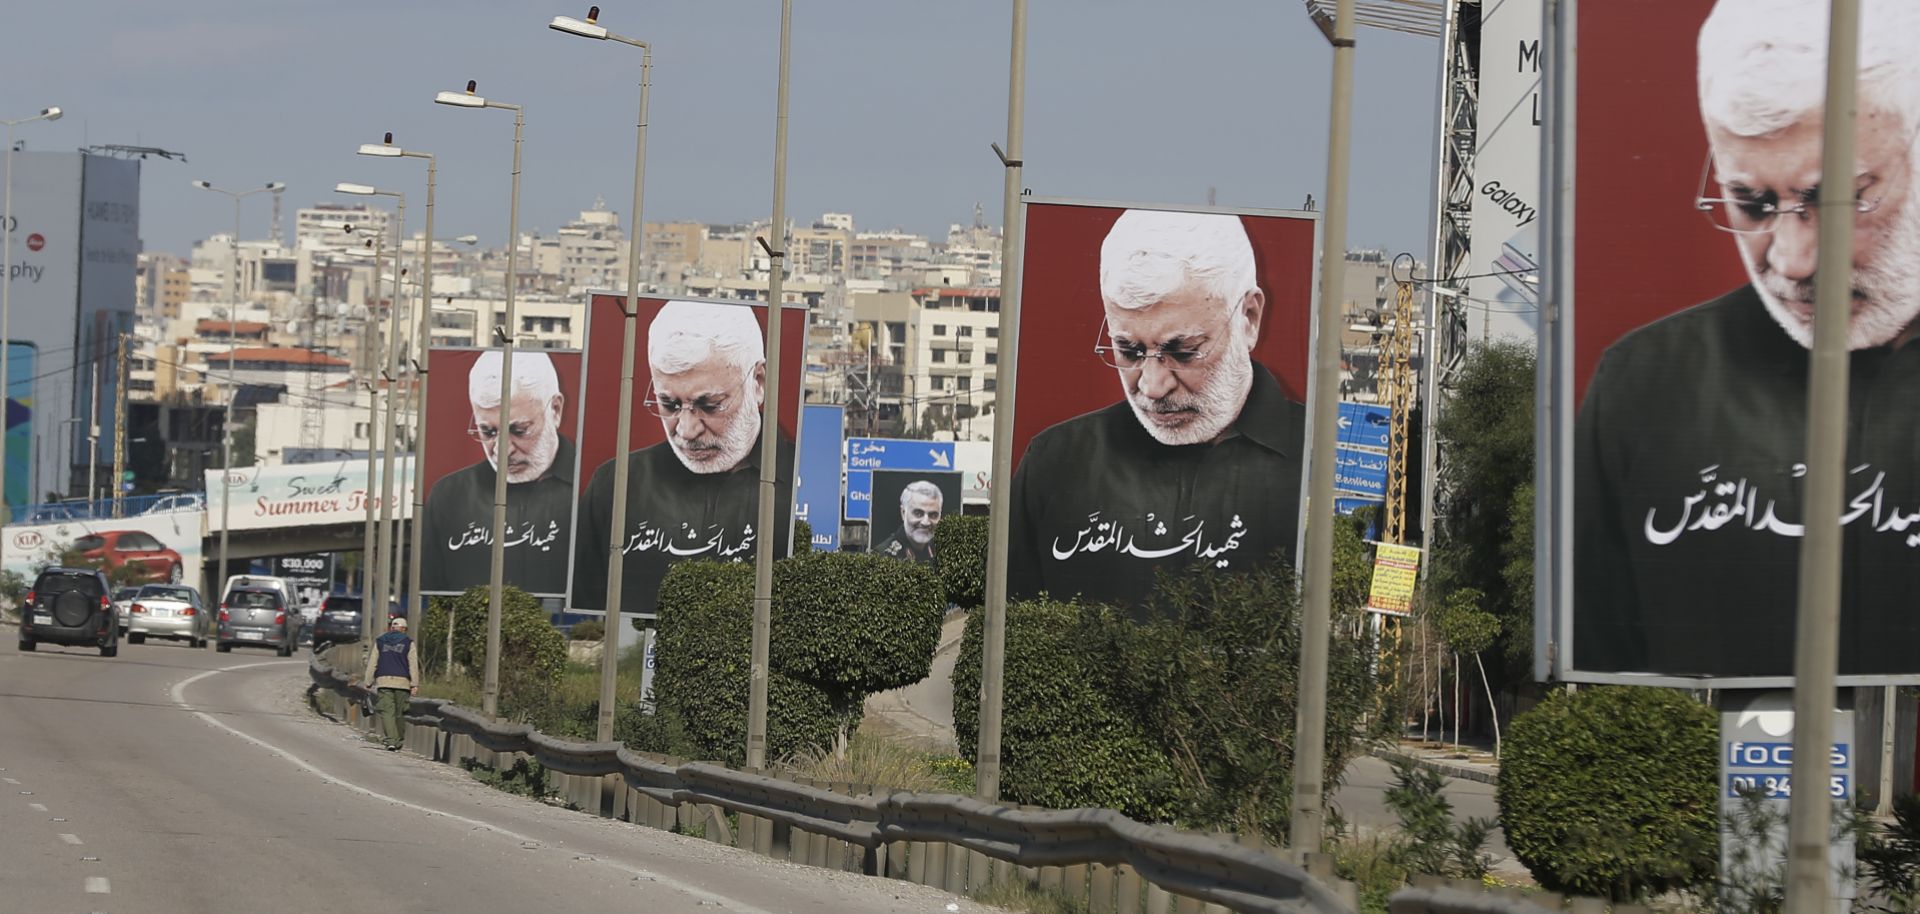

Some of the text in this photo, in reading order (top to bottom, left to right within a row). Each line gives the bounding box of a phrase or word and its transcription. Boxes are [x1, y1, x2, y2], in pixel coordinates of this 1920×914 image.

[1481, 180, 1537, 228] Galaxy
[851, 456, 882, 468] Sortie
[852, 441, 886, 456] مخرج
[254, 496, 340, 517] Summer
[531, 520, 559, 551] شهيد
[720, 523, 757, 563] شهيد
[1197, 514, 1248, 568] شهيد
[1729, 742, 1847, 765] focs
